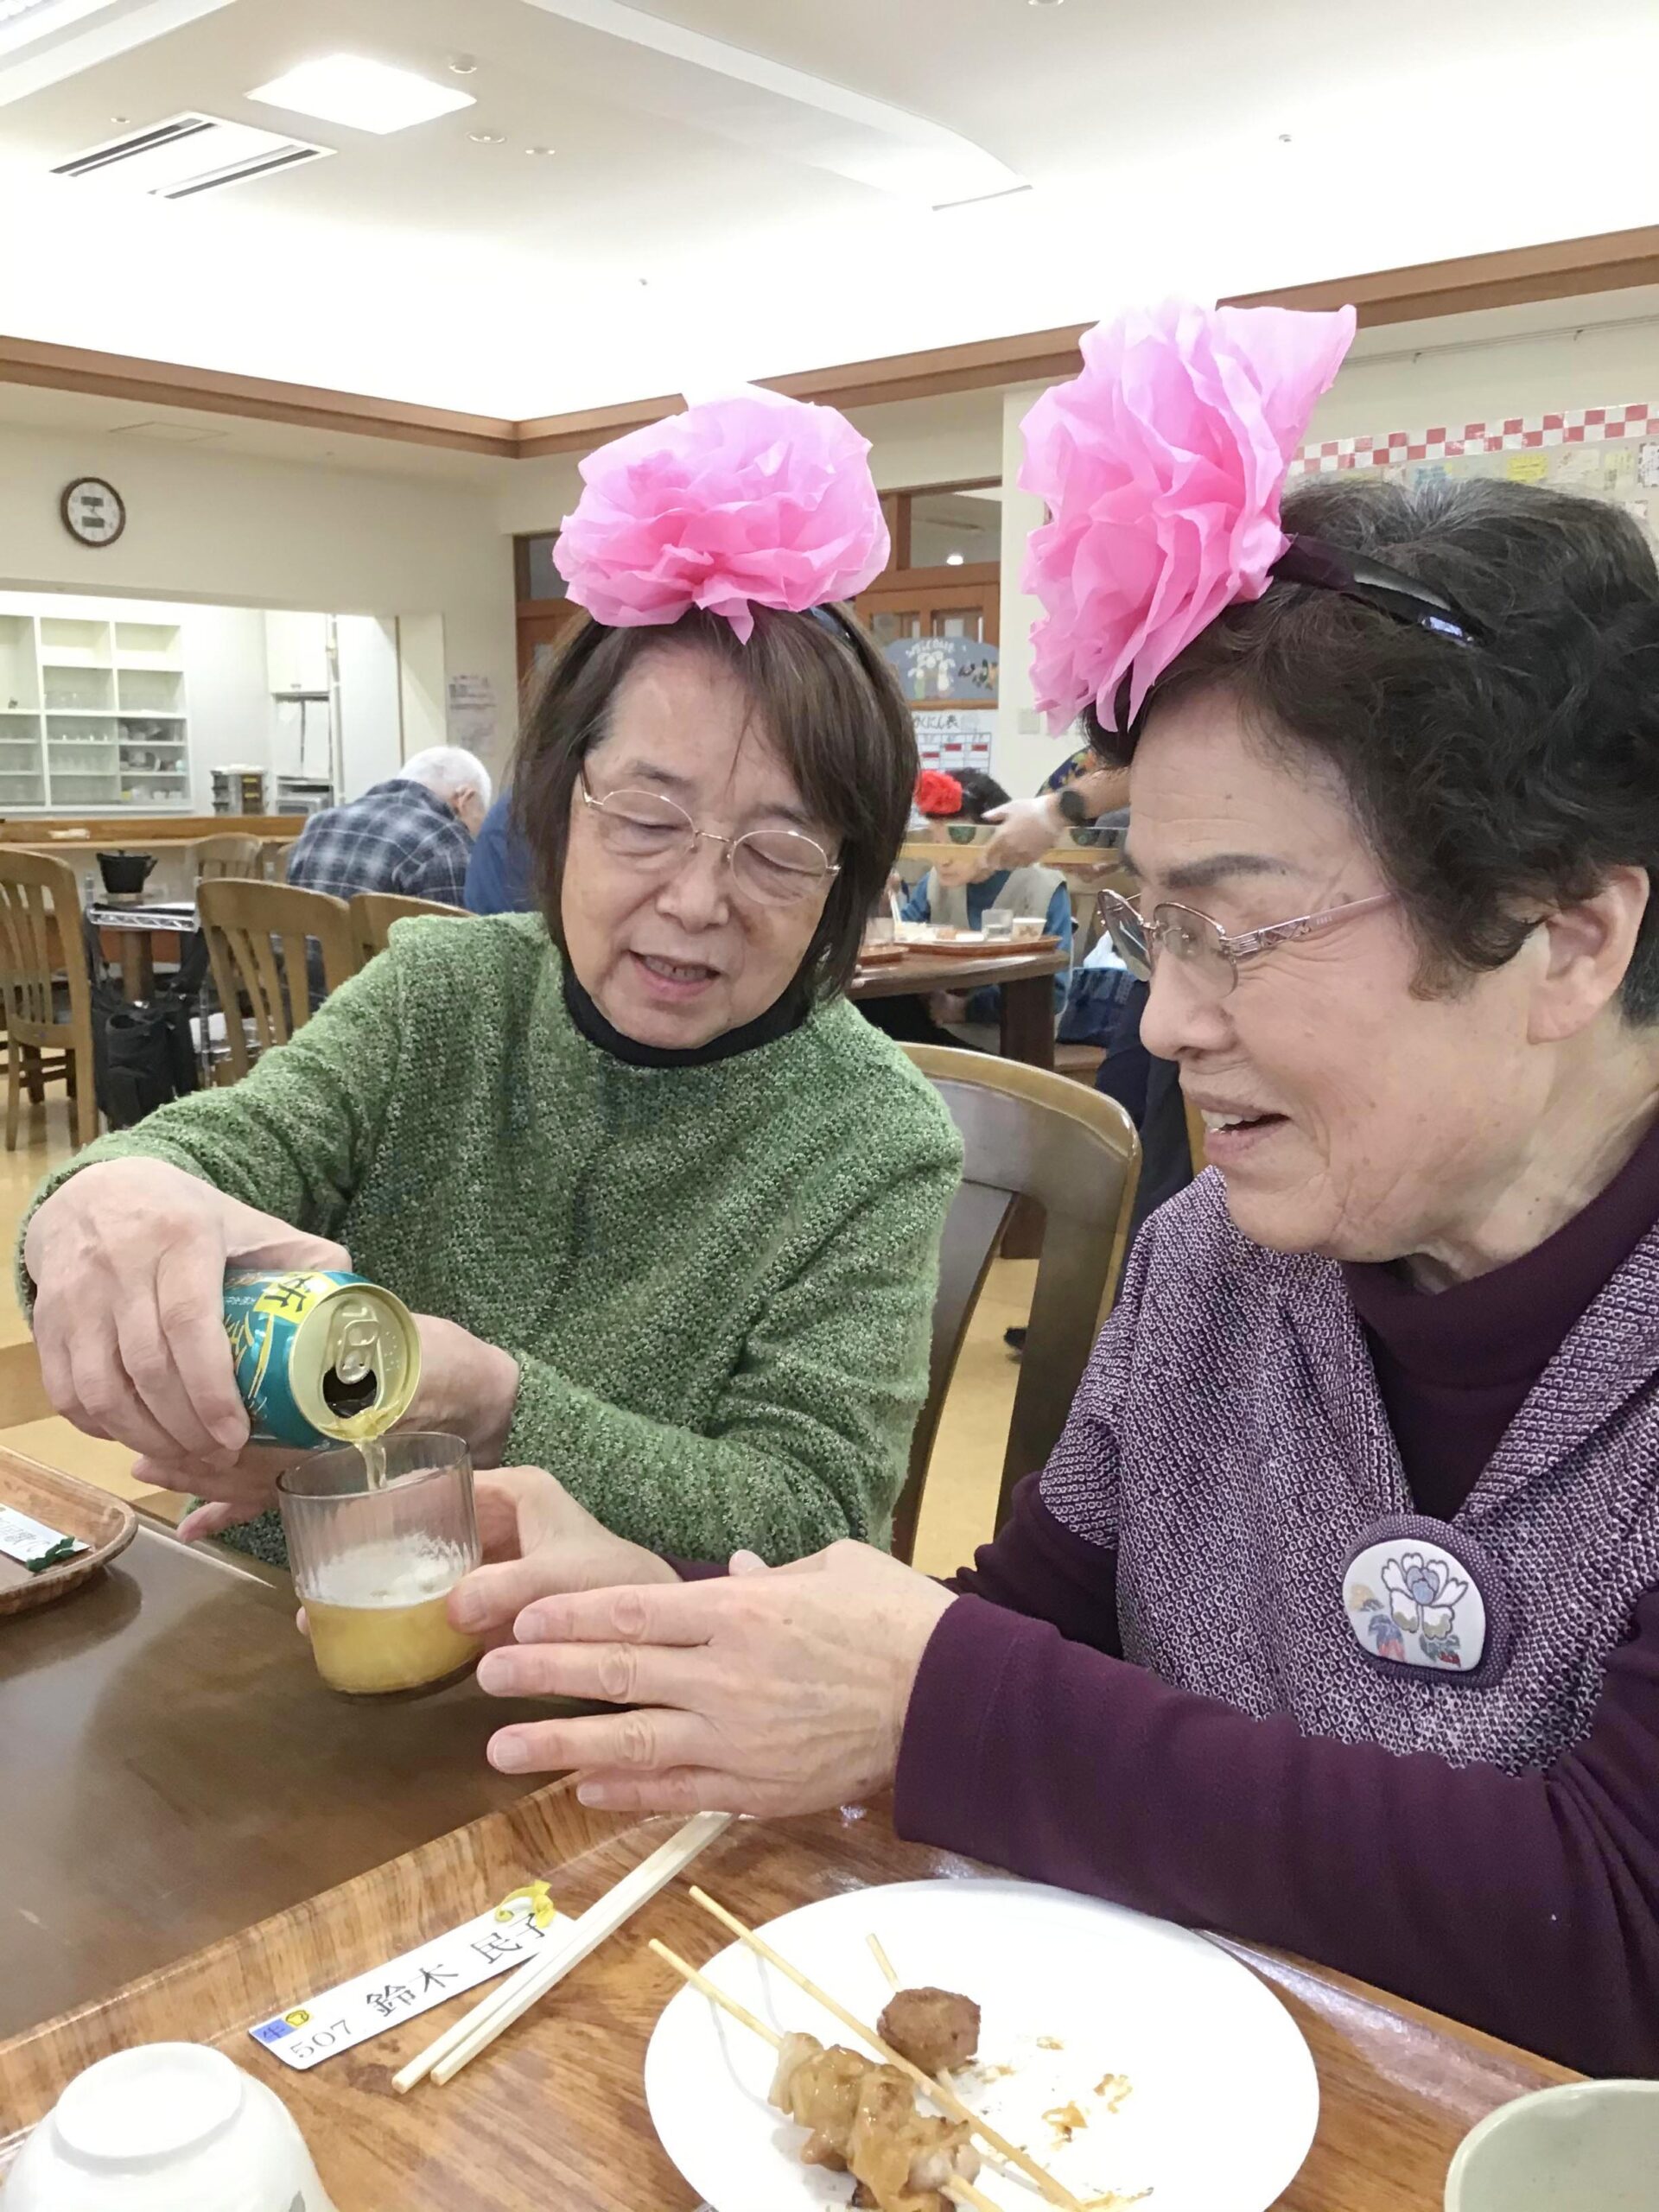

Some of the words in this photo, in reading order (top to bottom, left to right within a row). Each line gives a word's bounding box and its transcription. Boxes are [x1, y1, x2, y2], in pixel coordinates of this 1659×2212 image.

[290, 2019, 352, 2058] 507
[366, 1963, 459, 2018] 鈴木
[470, 1912, 545, 1964] 民子
